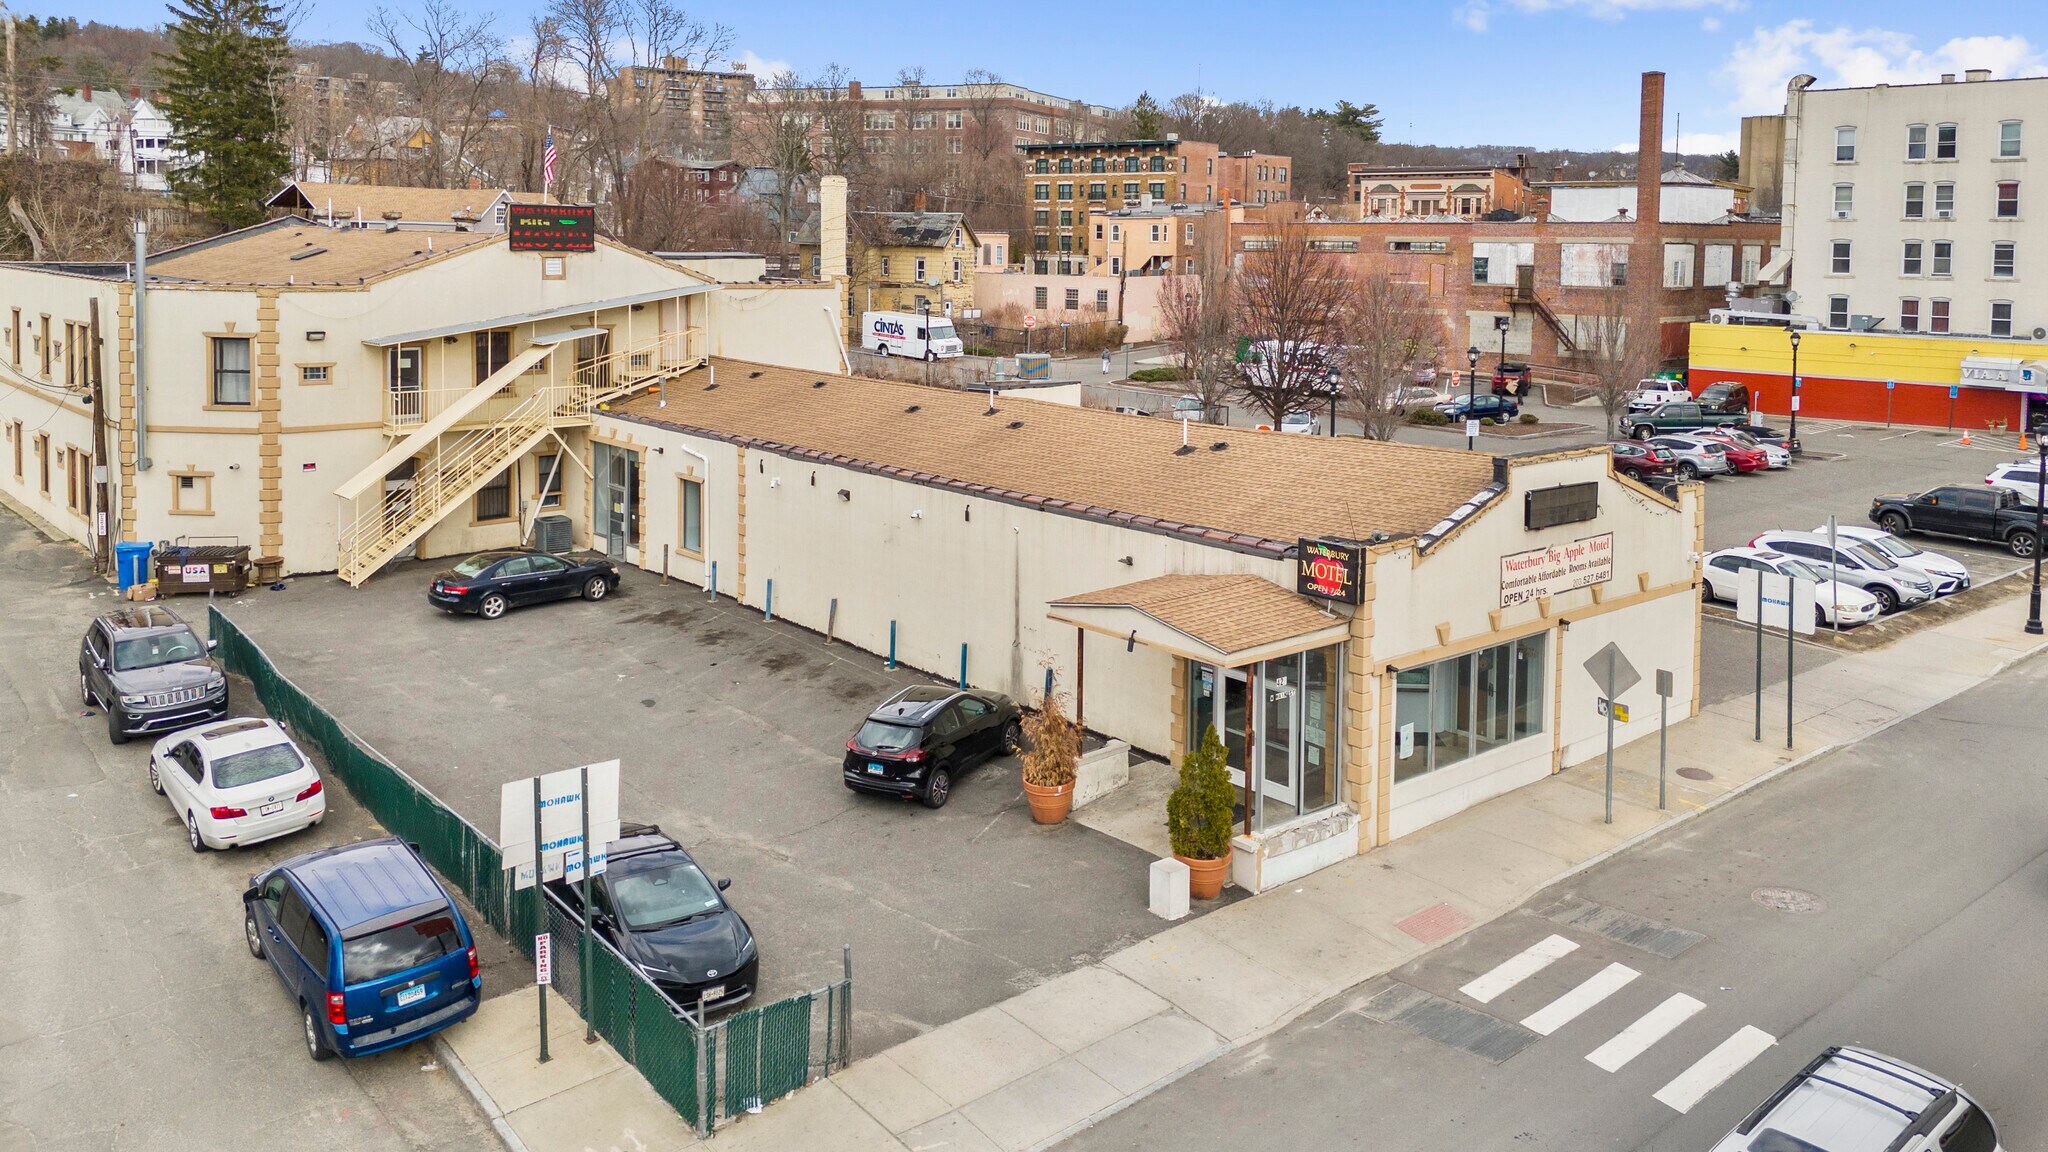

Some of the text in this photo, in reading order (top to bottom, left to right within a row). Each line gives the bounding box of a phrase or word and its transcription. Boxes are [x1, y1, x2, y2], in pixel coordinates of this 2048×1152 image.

[1306, 545, 1350, 561] WATERBURY
[1505, 537, 1610, 572] Waterbury Big Apple Motel
[185, 566, 206, 574] USA
[1301, 560, 1353, 586] MOTEL
[1501, 556, 1611, 590] Comfortable Affordable Rooms Available
[1306, 582, 1329, 594] OPEN
[1503, 592, 1523, 604] OPEN
[1525, 589, 1534, 599] 24
[540, 793, 581, 808] MOHAWK
